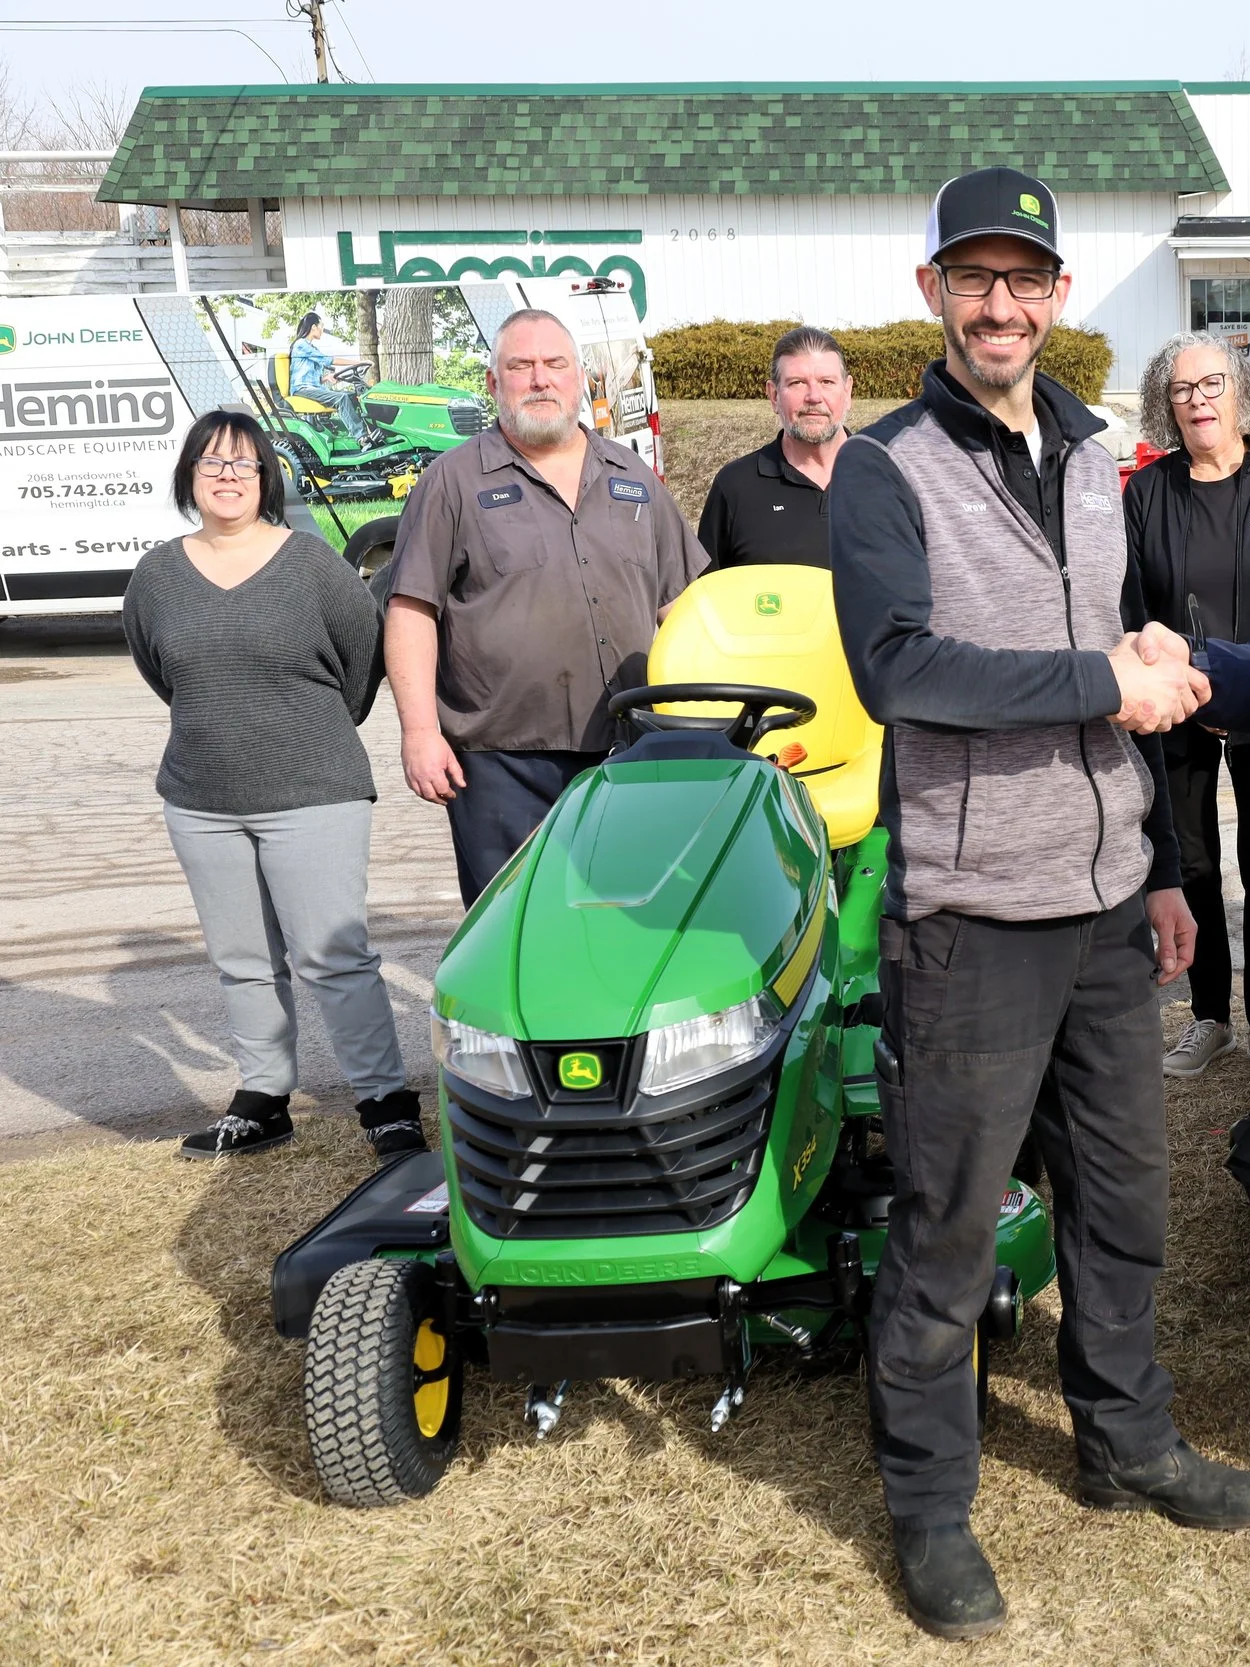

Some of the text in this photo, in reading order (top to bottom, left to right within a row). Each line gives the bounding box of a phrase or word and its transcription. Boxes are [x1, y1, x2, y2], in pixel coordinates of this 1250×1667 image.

[1011, 209, 1049, 229] JOHN DEERE
[670, 228, 735, 241] 2068
[23, 329, 143, 346] JOHN DEERE
[0, 440, 177, 457] NDSCAPE EQUIPMENT
[27, 473, 54, 483] 2068
[58, 471, 122, 482] Lansdowne
[18, 482, 153, 499] 705.742.6249
[492, 492, 509, 501] Dan
[614, 483, 643, 497] Heming
[51, 499, 126, 509] hemingltd.ca
[962, 503, 987, 512] Drew
[1079, 492, 1113, 512] Heming
[2, 542, 51, 557] arts
[793, 1133, 817, 1191] X354
[503, 1259, 700, 1283] JOHN DEERE
